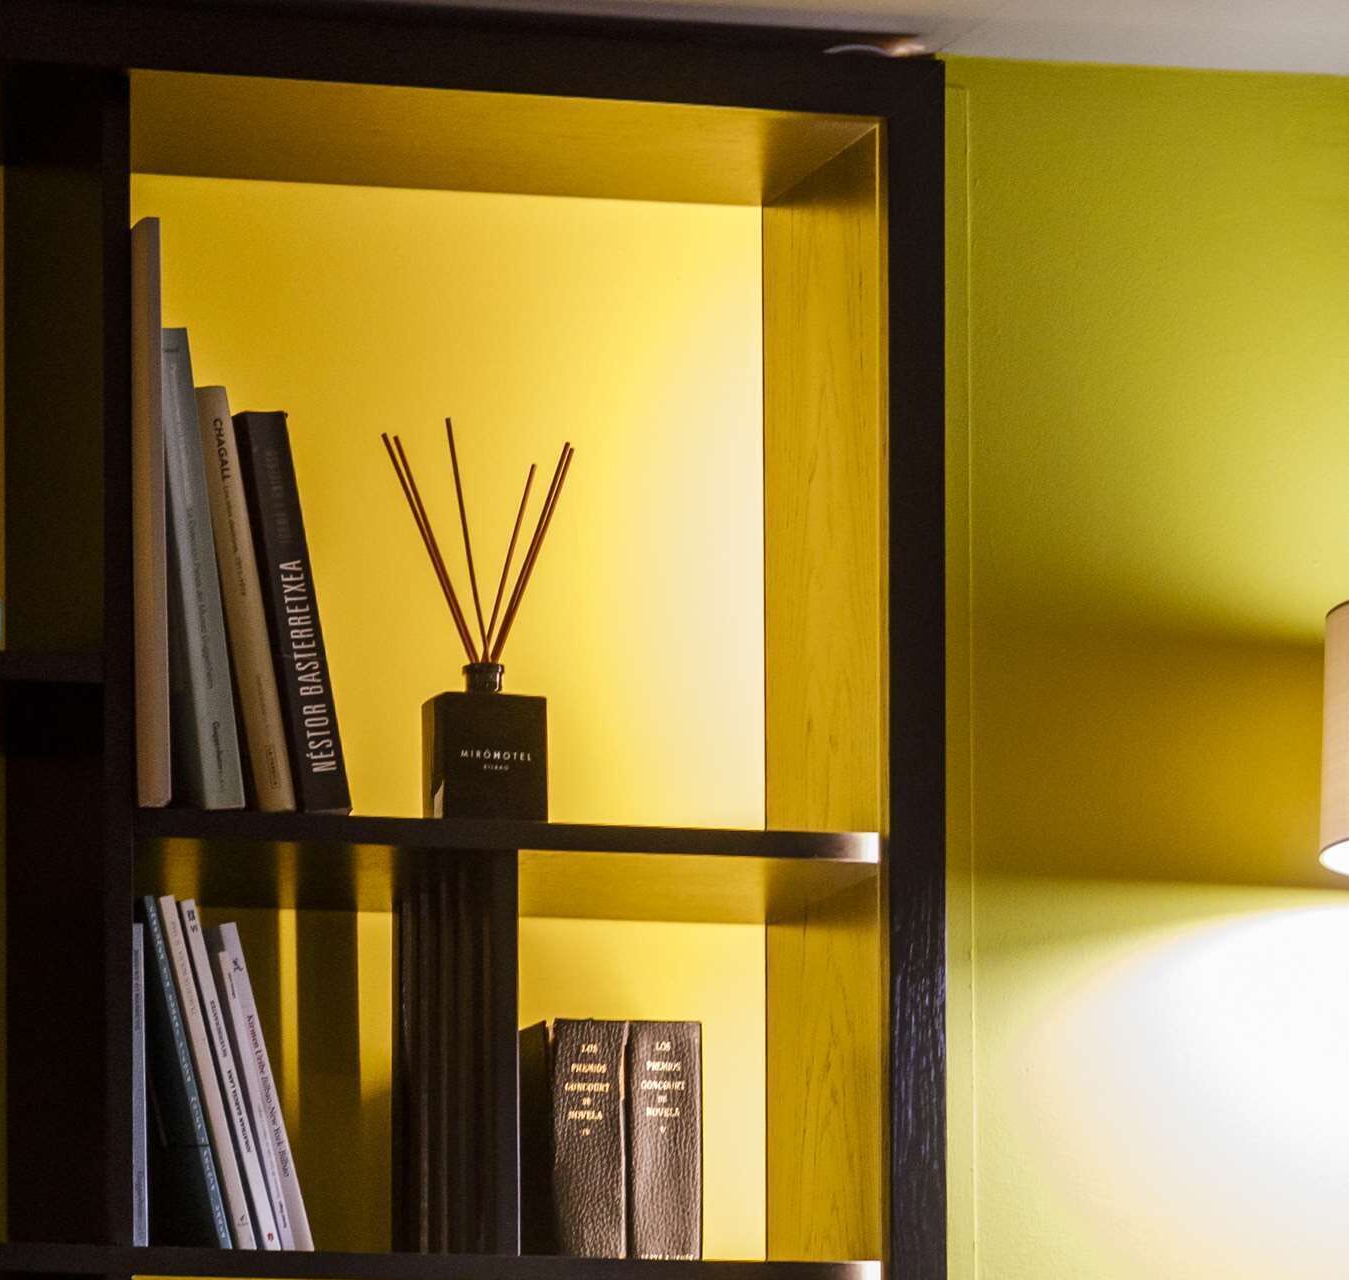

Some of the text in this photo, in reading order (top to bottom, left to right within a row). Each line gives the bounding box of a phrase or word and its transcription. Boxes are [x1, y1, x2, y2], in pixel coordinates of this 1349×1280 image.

[212, 417, 232, 482] CHAGALL
[281, 560, 337, 773] NÉSTOR BASTERRETXEA
[246, 1014, 260, 1048] Kirmen
[254, 1049, 266, 1075] Uribe
[655, 1041, 671, 1051] LOS
[568, 1110, 603, 1120] NOVELA
[646, 1107, 681, 1118] NOVELA
